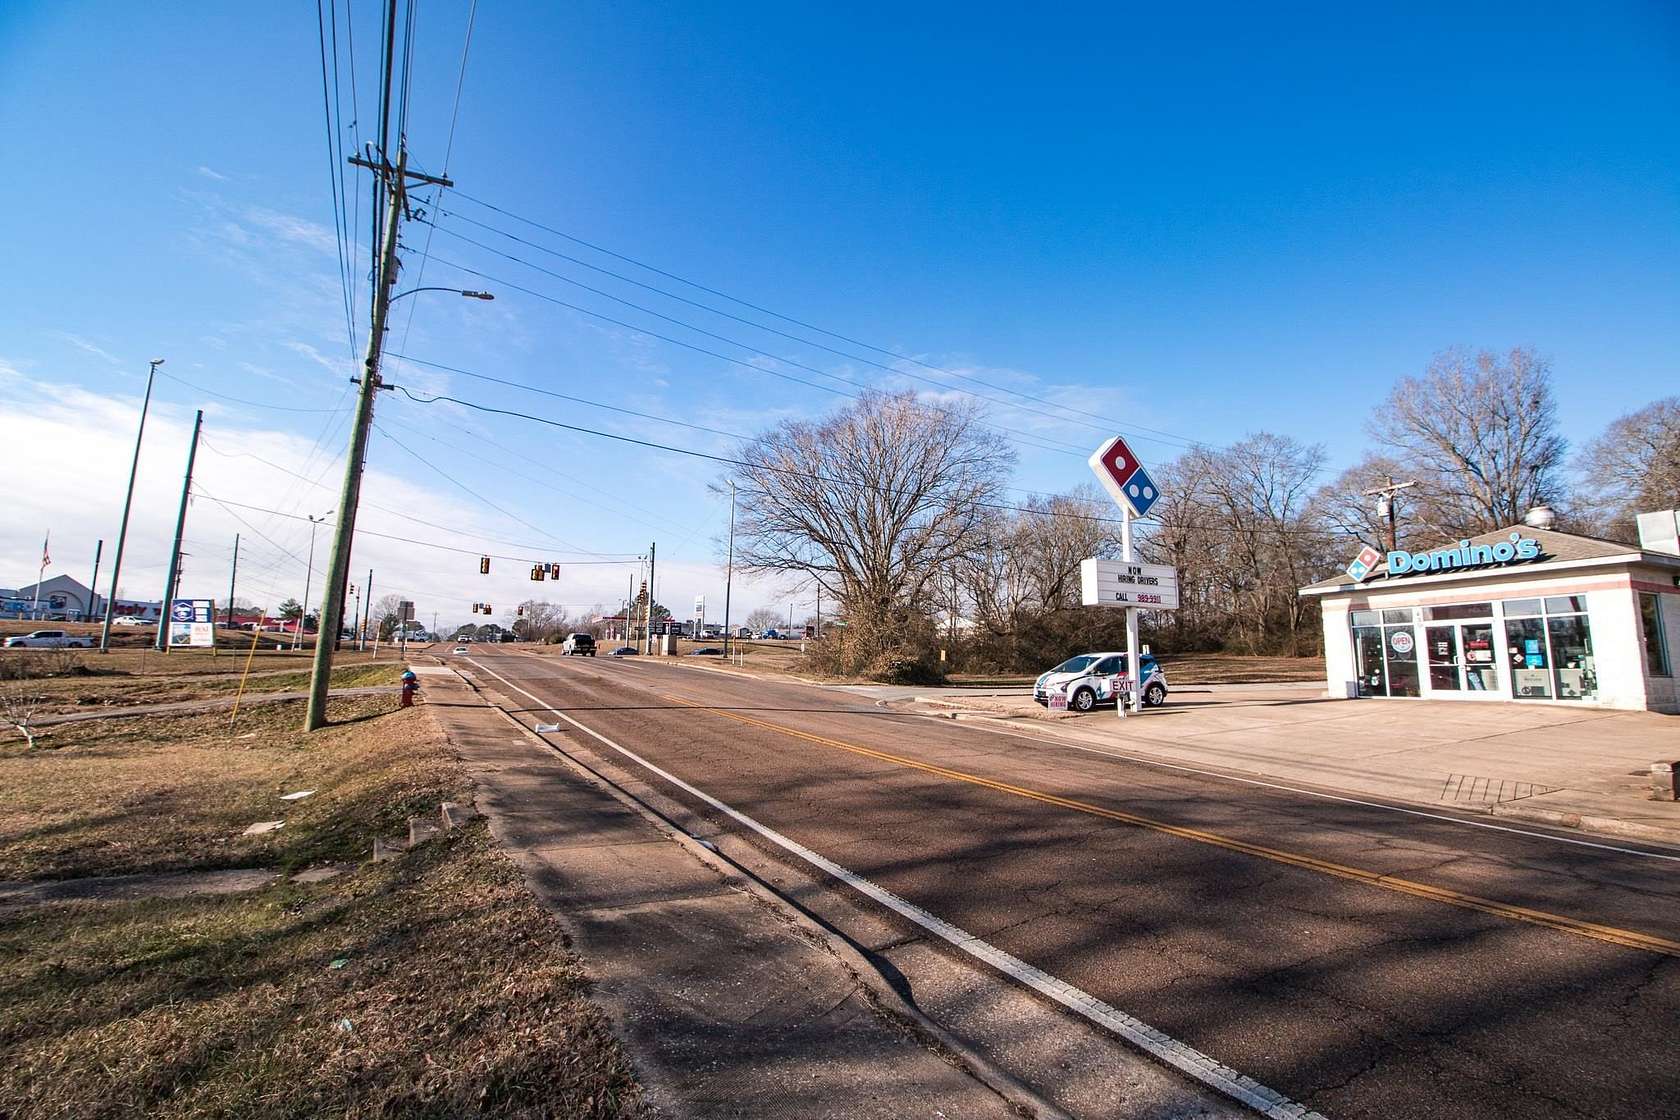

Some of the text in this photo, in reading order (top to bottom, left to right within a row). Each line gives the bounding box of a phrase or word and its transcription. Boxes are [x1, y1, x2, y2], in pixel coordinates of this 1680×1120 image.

[1387, 532, 1539, 574] Domino's
[1128, 566, 1142, 576] NOW
[1118, 575, 1158, 586] HIRING DRIVERS
[1116, 592, 1128, 601] CALL
[1392, 636, 1410, 645] OPEN
[1113, 681, 1134, 691] EXIT
